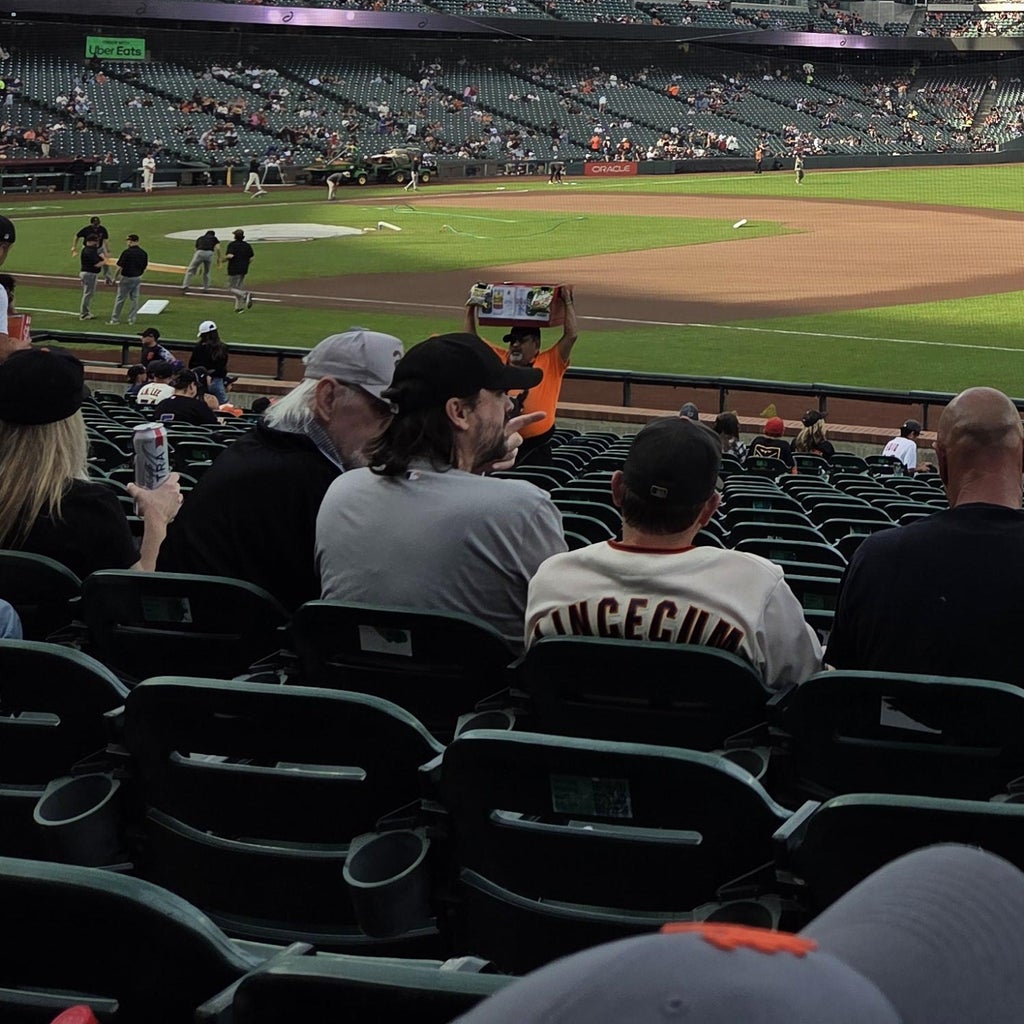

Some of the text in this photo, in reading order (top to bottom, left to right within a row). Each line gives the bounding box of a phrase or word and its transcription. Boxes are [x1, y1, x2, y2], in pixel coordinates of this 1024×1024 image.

[89, 45, 142, 56] Uber Eats
[592, 165, 630, 173] ORACLE
